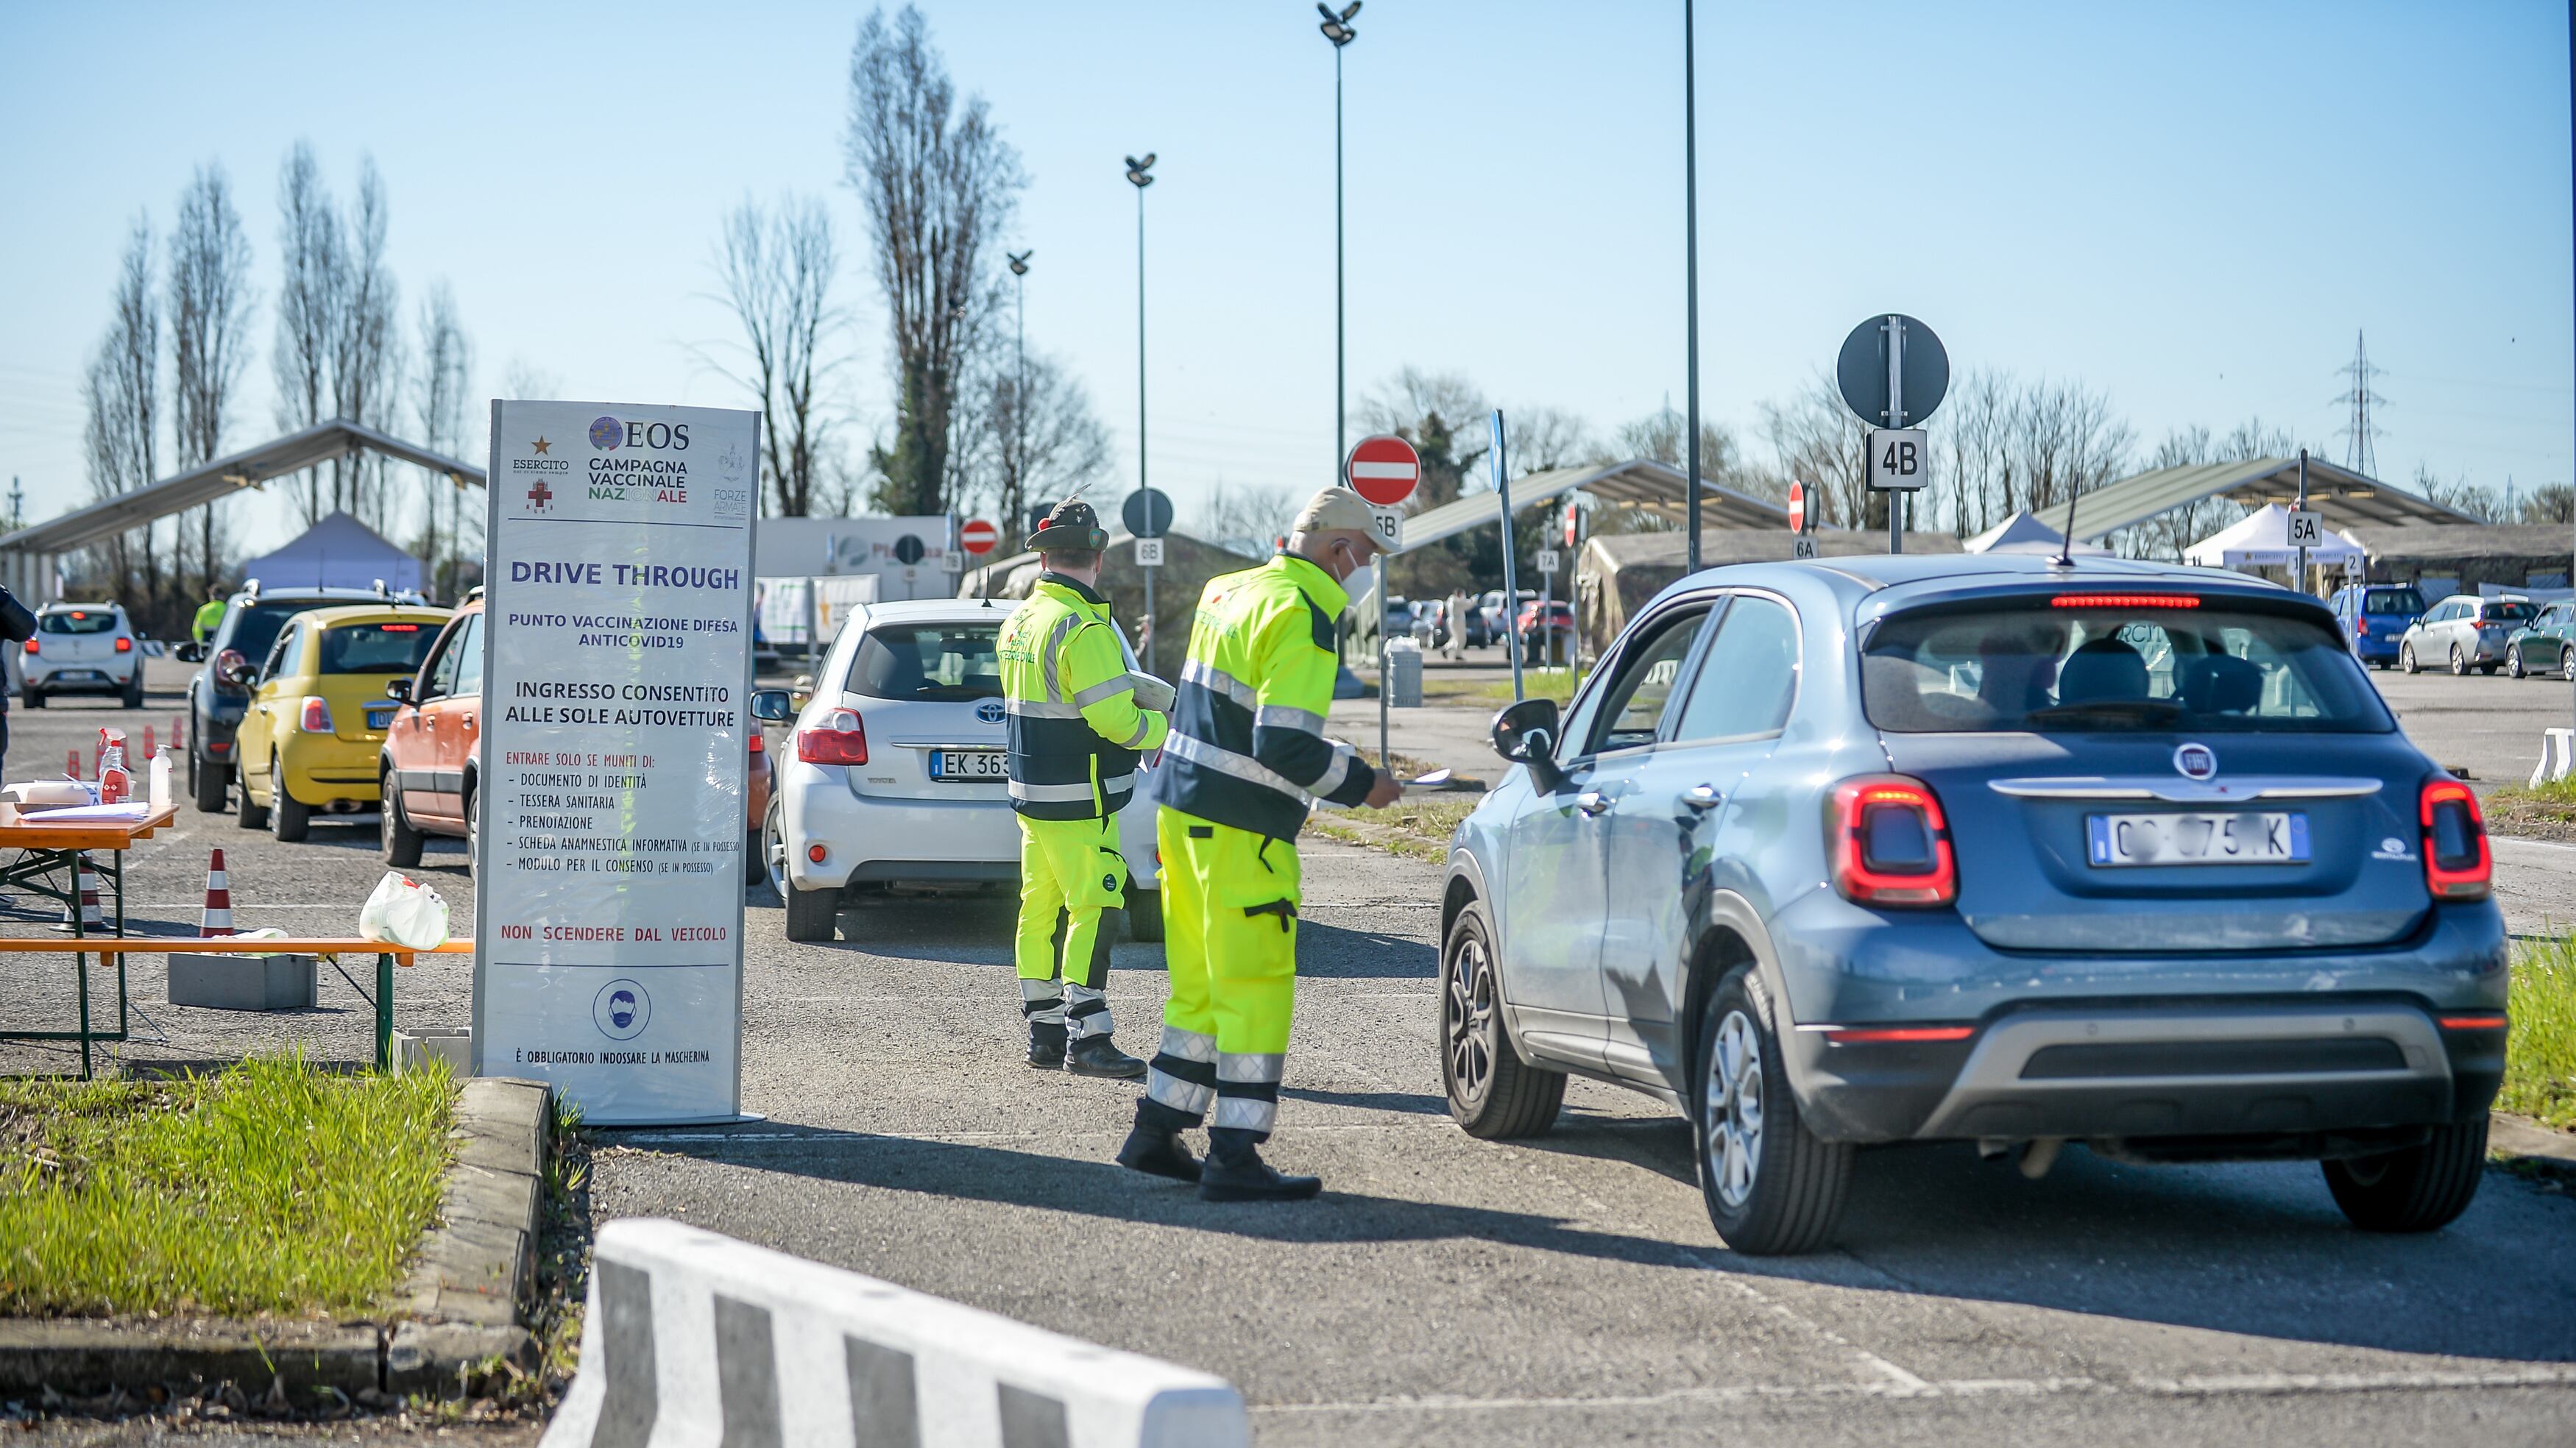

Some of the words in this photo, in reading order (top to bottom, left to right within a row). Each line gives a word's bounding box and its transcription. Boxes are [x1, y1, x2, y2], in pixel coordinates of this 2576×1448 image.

[626, 422, 689, 450] EOS
[513, 460, 569, 469] ESERCITO
[590, 458, 687, 474] CAMPAGNA
[1883, 441, 1917, 475] 4B
[589, 472, 685, 488] VACCINALE
[589, 487, 687, 503] NAZIONALE
[715, 489, 746, 501] FORZE
[714, 501, 746, 512] ARMATE
[1376, 517, 1395, 536] 5B
[2294, 519, 2315, 539] 5A
[1142, 544, 1158, 558] 6B
[1797, 542, 1814, 557] 6A
[1542, 555, 1554, 567] 7A
[2349, 556, 2356, 569] 2
[511, 561, 601, 584] DRIVE
[612, 564, 738, 590] THROUGH
[509, 614, 566, 627] PUNTO
[573, 615, 688, 631] VACCINAZIONE
[693, 620, 737, 633] DIFESA
[578, 634, 684, 649] ANTICOVID19
[515, 681, 615, 700] INGRESSO
[622, 685, 729, 703] CONSENTITO
[505, 706, 553, 723] ALLE
[559, 708, 609, 724] SOLE
[614, 709, 735, 727] AUTOVETTURE
[506, 752, 549, 765] ENTRARE
[556, 753, 581, 766] SOLO
[587, 754, 598, 767] SE
[604, 755, 637, 767] MUNITI
[643, 756, 654, 768] DI:
[945, 753, 967, 773] EK
[2184, 753, 2209, 770] FIAT
[521, 774, 581, 787] DOCUMENTO
[588, 776, 598, 787] DI
[604, 773, 646, 789] IDENTITÀ
[520, 795, 560, 808] TESSERA
[566, 796, 615, 809] SANITARIA
[520, 816, 592, 830] PRENOTAZIONE
[519, 837, 556, 850] SCHEDA
[561, 838, 626, 851] ANAMNESTICA
[632, 840, 687, 852] INFORMATIVA
[691, 842, 701, 854] (SE
[704, 842, 710, 851] IN
[518, 858, 560, 871] MODULO
[567, 859, 585, 871] PER
[592, 859, 601, 871] IL
[606, 860, 653, 873] CONSENSO
[658, 862, 668, 876] (SE
[672, 862, 679, 873] IN
[682, 862, 713, 875] POSSESSO)
[501, 926, 532, 939] NON
[543, 926, 624, 941] SCENDERE
[635, 928, 662, 941] DAL
[671, 928, 726, 941] VEICOLO
[516, 1048, 521, 1062] È
[528, 1051, 595, 1064] OBBLIGATORIO
[600, 1051, 646, 1064] INDOSSARE
[651, 1051, 660, 1063] LA
[665, 1051, 710, 1062] MASCHERINA
